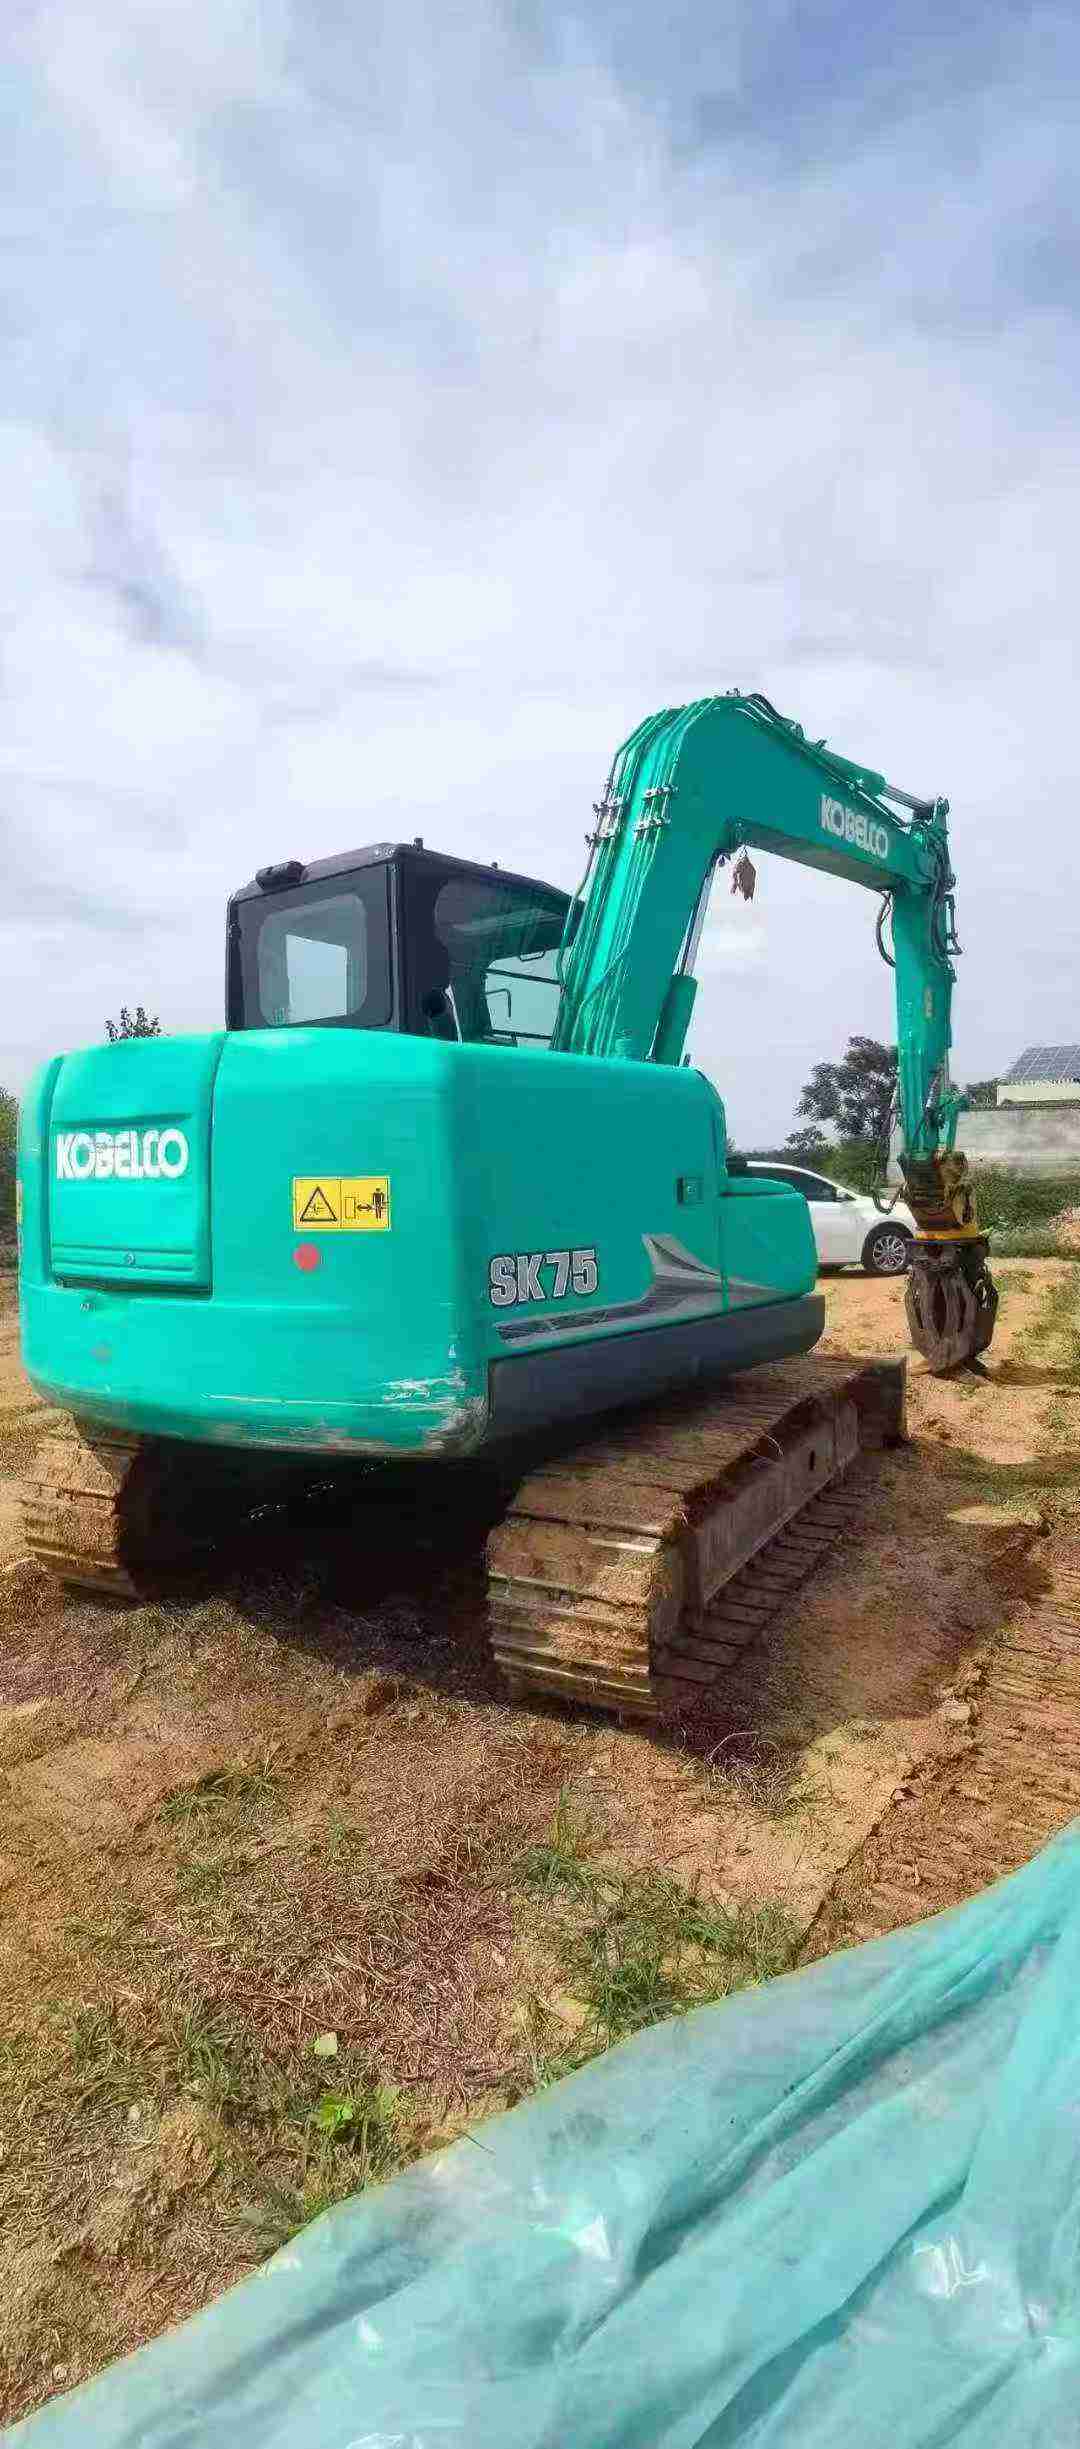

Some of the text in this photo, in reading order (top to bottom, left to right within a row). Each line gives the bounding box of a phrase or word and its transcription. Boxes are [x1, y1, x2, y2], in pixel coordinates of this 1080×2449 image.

[821, 795, 889, 858] KOBELCO
[56, 1129, 188, 1179] KOBELCO
[489, 1249, 599, 1306] SK75
